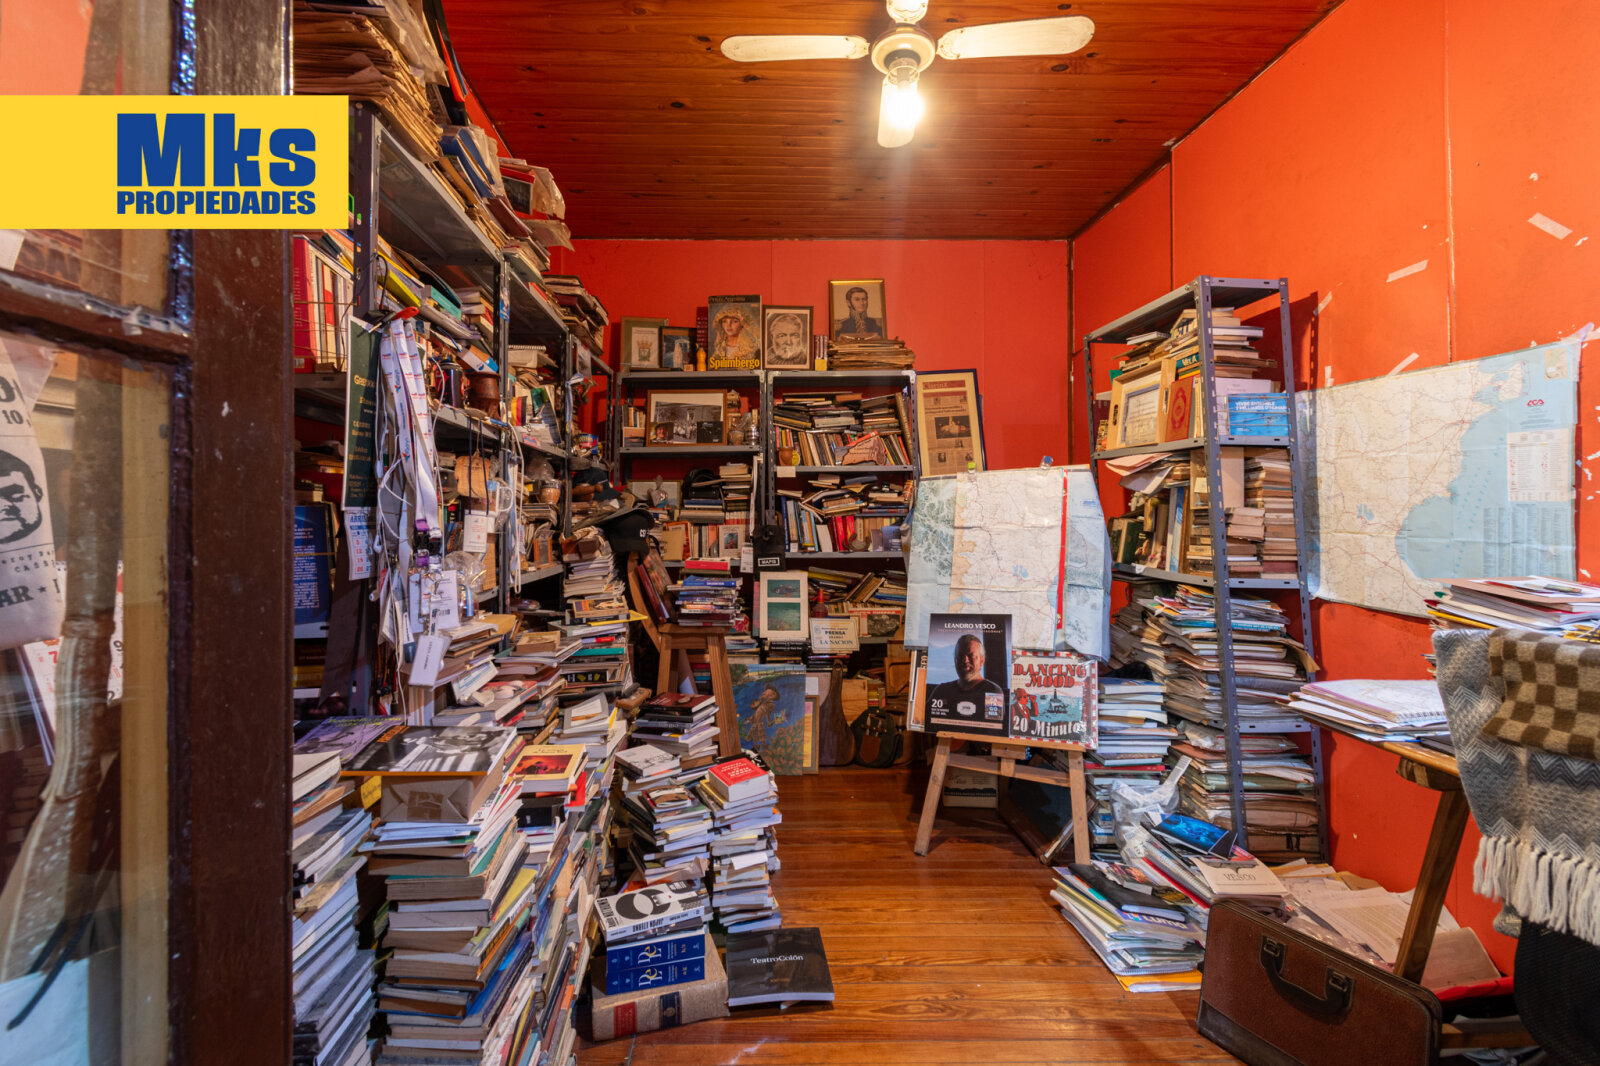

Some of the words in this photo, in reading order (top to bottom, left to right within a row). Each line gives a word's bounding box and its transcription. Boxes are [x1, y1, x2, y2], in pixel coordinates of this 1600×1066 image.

[709, 356, 760, 370] Spilimbergo
[944, 622, 974, 630] LEANDRO
[1012, 663, 1087, 679] DANCING
[1025, 675, 1075, 688] MOOD
[930, 698, 944, 709] 20
[1012, 715, 1029, 733] 20
[750, 954, 804, 964] TeatroColón
